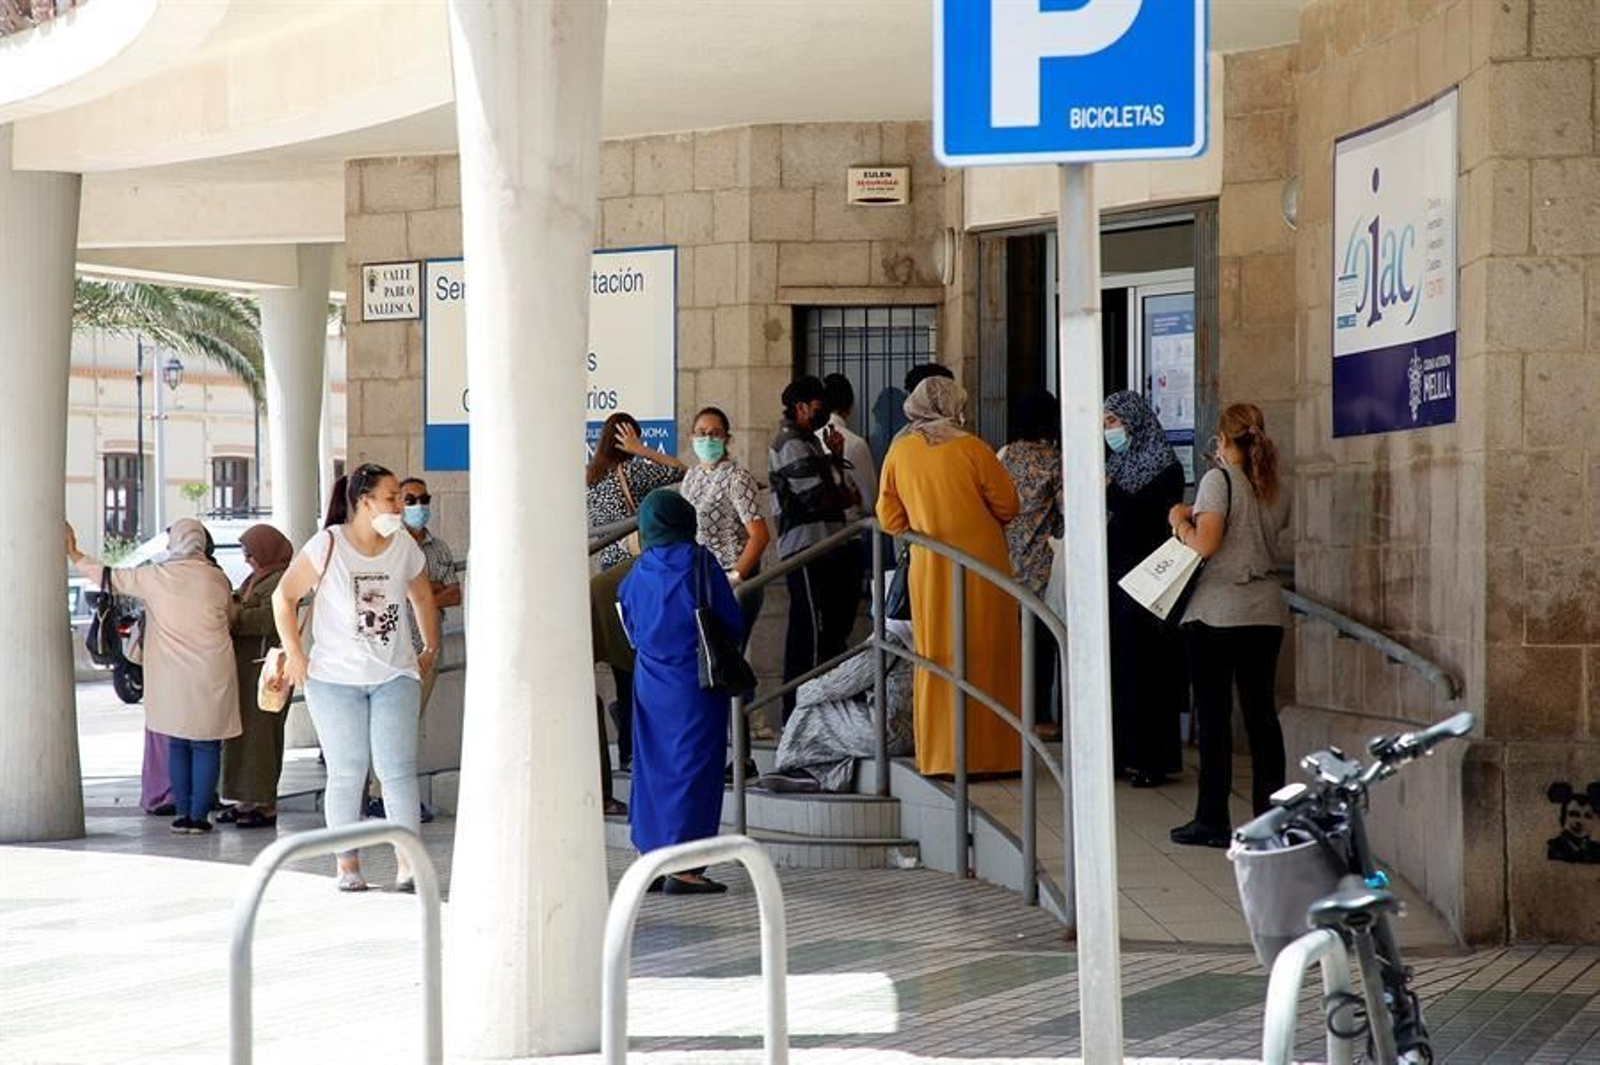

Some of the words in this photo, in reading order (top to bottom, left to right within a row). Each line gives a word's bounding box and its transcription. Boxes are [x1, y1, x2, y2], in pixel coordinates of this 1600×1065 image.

[990, 0, 1144, 128] P
[1069, 104, 1165, 129] BICICLETAS
[383, 269, 410, 280] CALLE
[384, 285, 415, 297] PABLO
